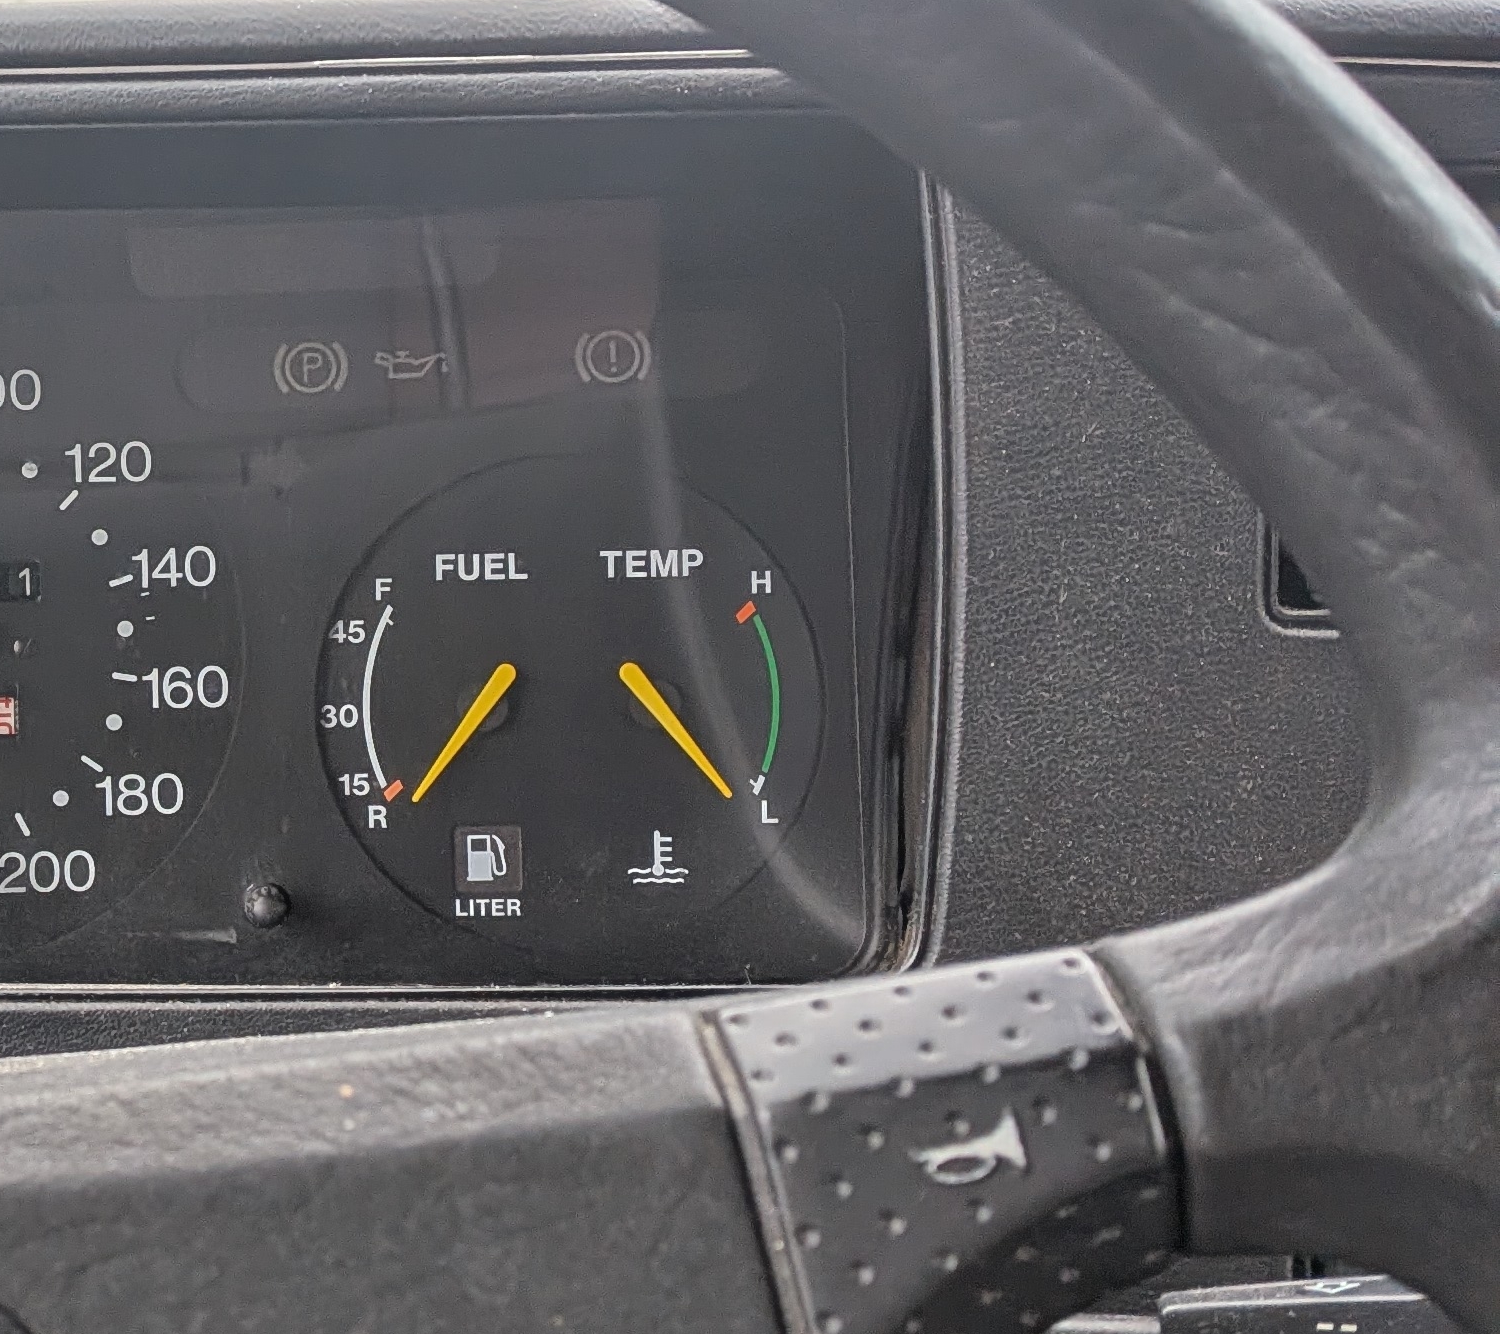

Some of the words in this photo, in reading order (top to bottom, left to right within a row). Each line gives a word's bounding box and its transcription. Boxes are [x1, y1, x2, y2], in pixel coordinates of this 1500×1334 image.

[64, 440, 152, 483] 120
[130, 545, 217, 589] 140
[435, 552, 529, 581] FUEL
[599, 548, 704, 579] TEMP
[375, 577, 393, 601] F
[750, 570, 772, 595] H
[329, 619, 366, 644] 45
[141, 665, 229, 709] 160
[320, 703, 359, 728] 30
[95, 774, 184, 817] 180
[338, 772, 371, 796] 15
[367, 804, 388, 829] R
[761, 799, 779, 824] L
[455, 898, 522, 917] LITER
